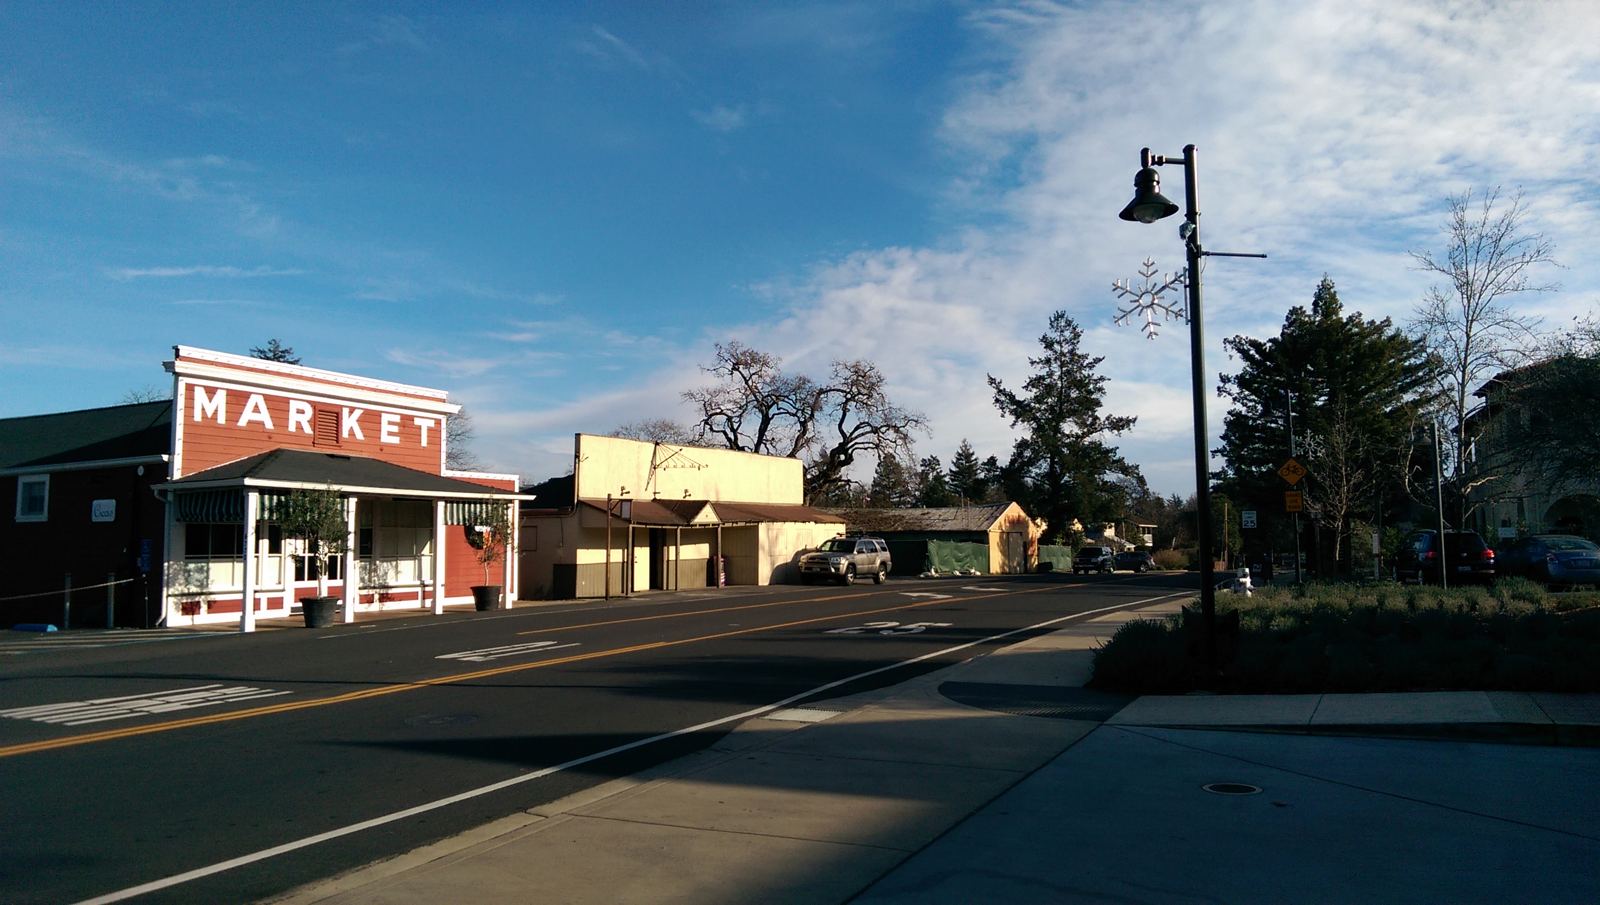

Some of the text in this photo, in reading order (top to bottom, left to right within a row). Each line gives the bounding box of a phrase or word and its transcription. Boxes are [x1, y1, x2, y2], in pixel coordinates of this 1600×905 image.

[192, 385, 435, 448] MARKET
[1243, 519, 1256, 528] 25
[823, 621, 953, 635] 25
